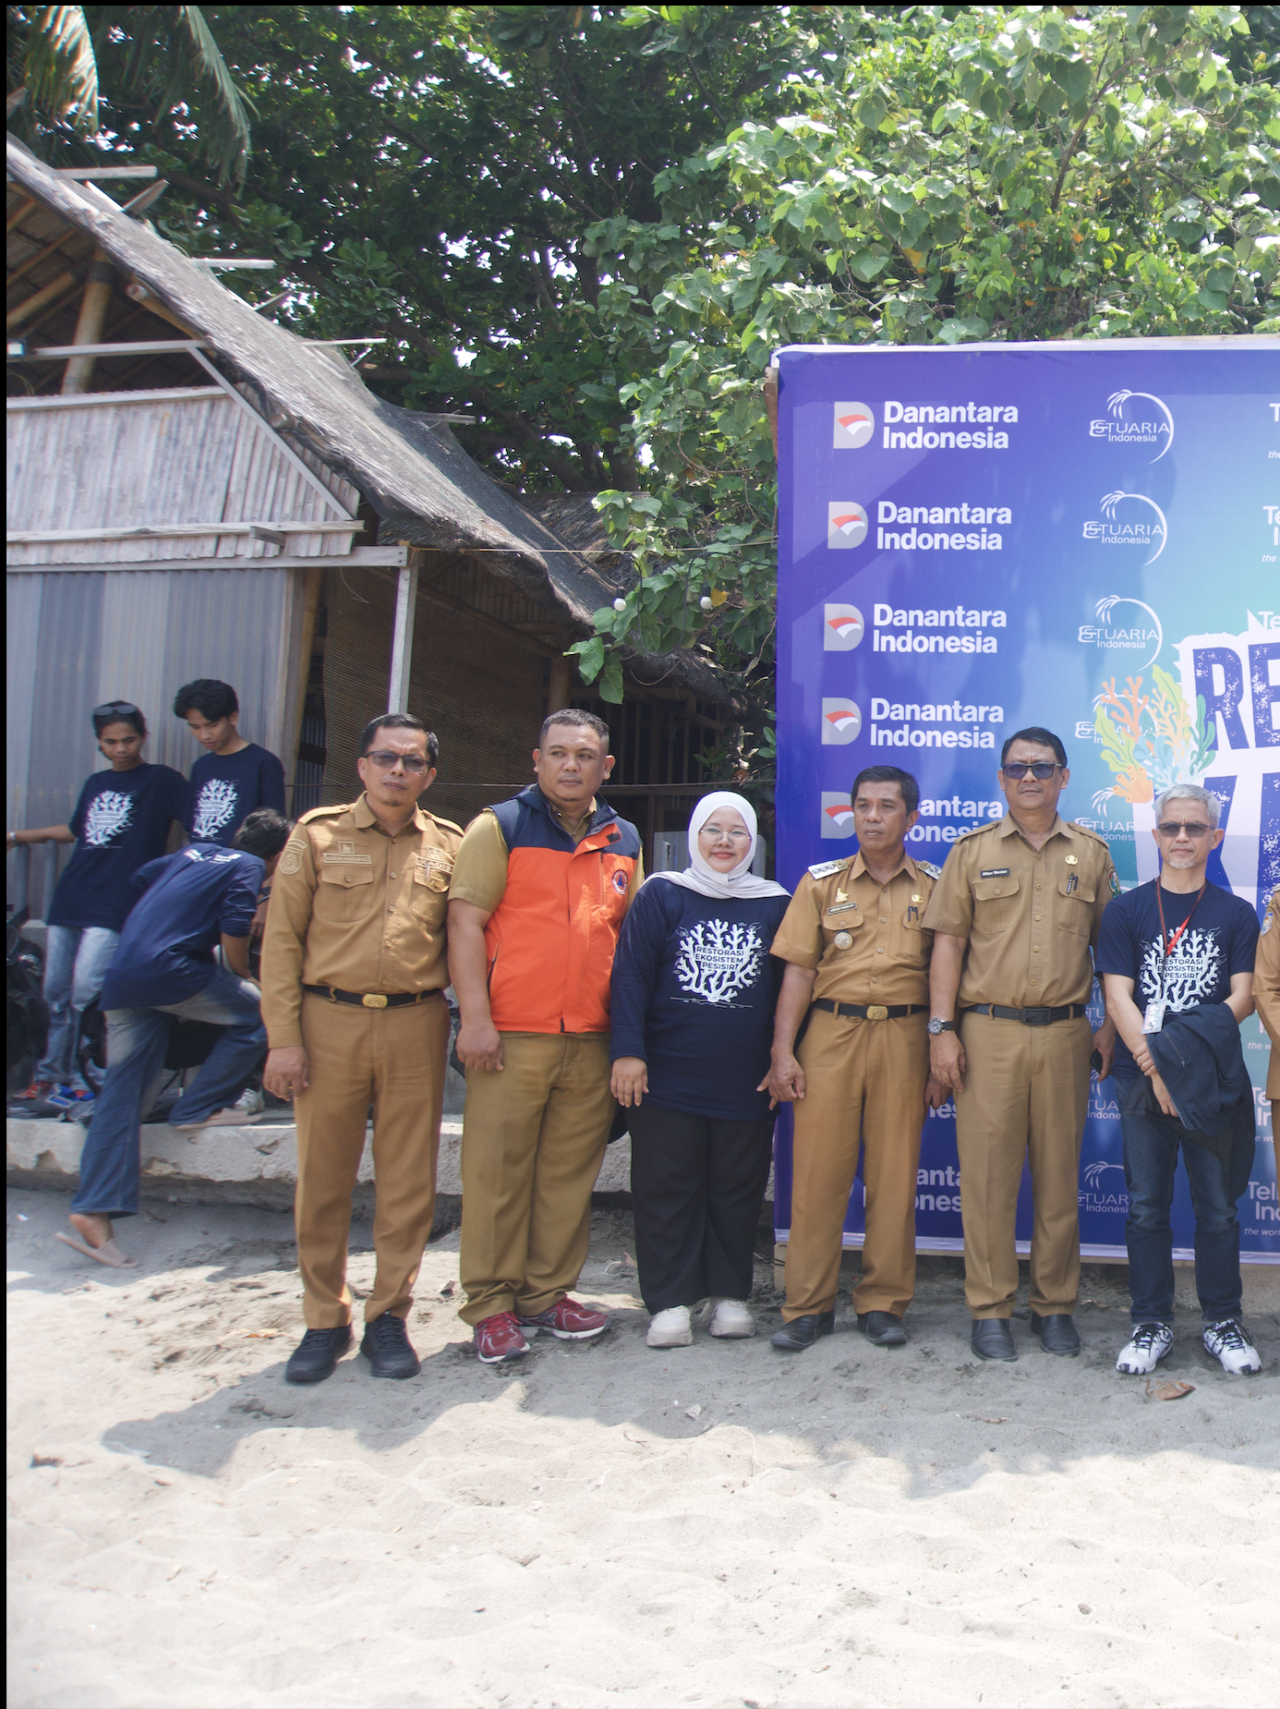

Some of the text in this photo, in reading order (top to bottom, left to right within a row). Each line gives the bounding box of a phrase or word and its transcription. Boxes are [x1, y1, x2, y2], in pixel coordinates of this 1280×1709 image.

[883, 400, 1019, 423] Danantara
[1089, 419, 1169, 437] ESTUARIA
[883, 426, 1009, 449] Indonesia
[1108, 433, 1157, 442] Indonesia
[877, 501, 1012, 525] Danantara
[877, 526, 1003, 551] Indonesia
[1082, 521, 1164, 539] ESTUARIA
[1101, 535, 1151, 544] Indonesia
[1261, 554, 1277, 563] the
[873, 604, 1007, 628] Danantara
[873, 630, 998, 654] Indonesia
[1077, 625, 1159, 643] ESTUARIA
[1096, 639, 1146, 649] Indonesia
[870, 698, 1004, 722] Danantara
[870, 724, 995, 749] Indonesia
[919, 796, 1004, 818] antara
[695, 954, 744, 964] EKOSISTEM
[696, 946, 744, 957] RESTORASI
[702, 962, 735, 970] PESISIR
[1086, 1203, 1129, 1214] Indonesi
[1244, 1227, 1259, 1235] the
